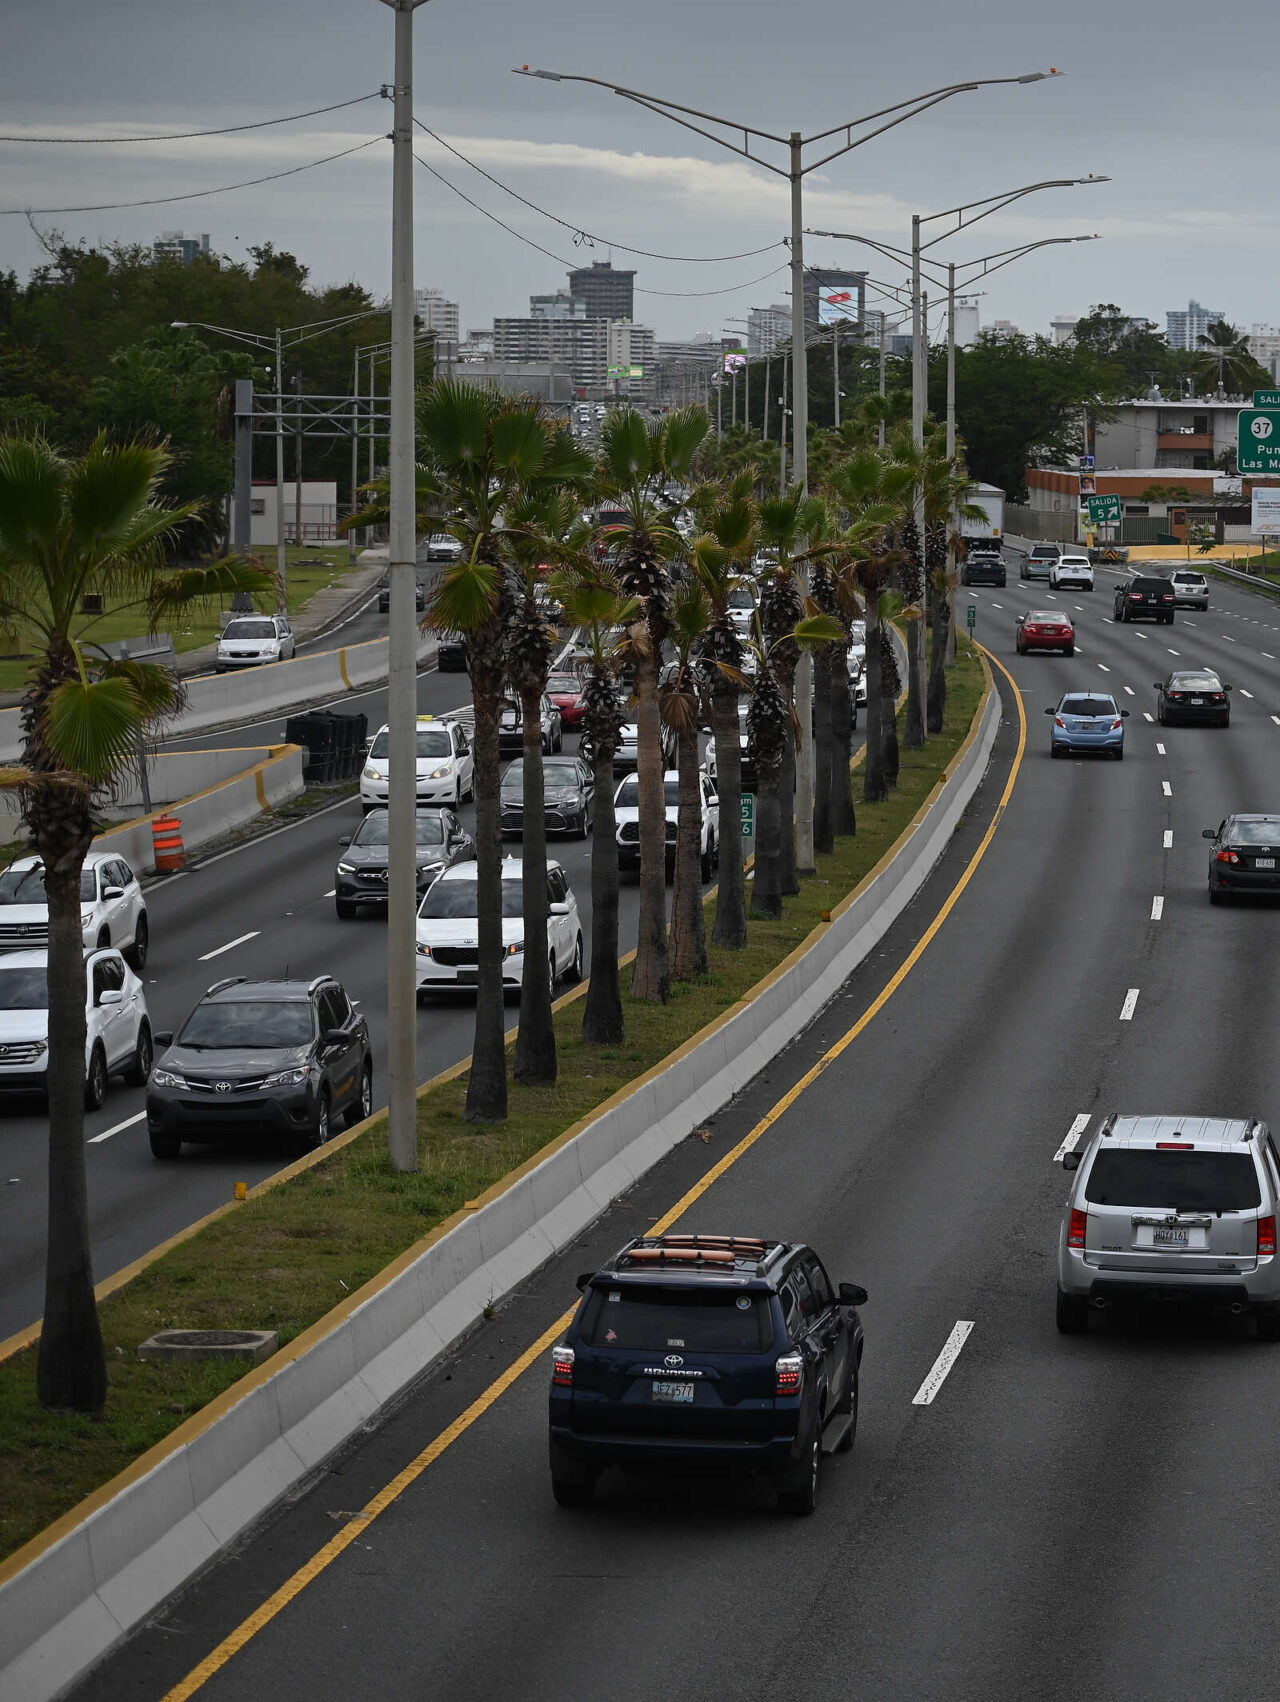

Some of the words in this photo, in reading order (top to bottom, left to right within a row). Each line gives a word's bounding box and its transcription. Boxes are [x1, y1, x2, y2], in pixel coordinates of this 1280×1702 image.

[1253, 422, 1270, 434] 37
[1242, 458, 1263, 468] Las
[1090, 497, 1117, 507] SALIDA
[1097, 509, 1105, 519] 5
[741, 806, 749, 818] 5
[742, 823, 750, 834] 6
[1174, 1231, 1187, 1241] 161
[676, 1385, 692, 1397] 577
